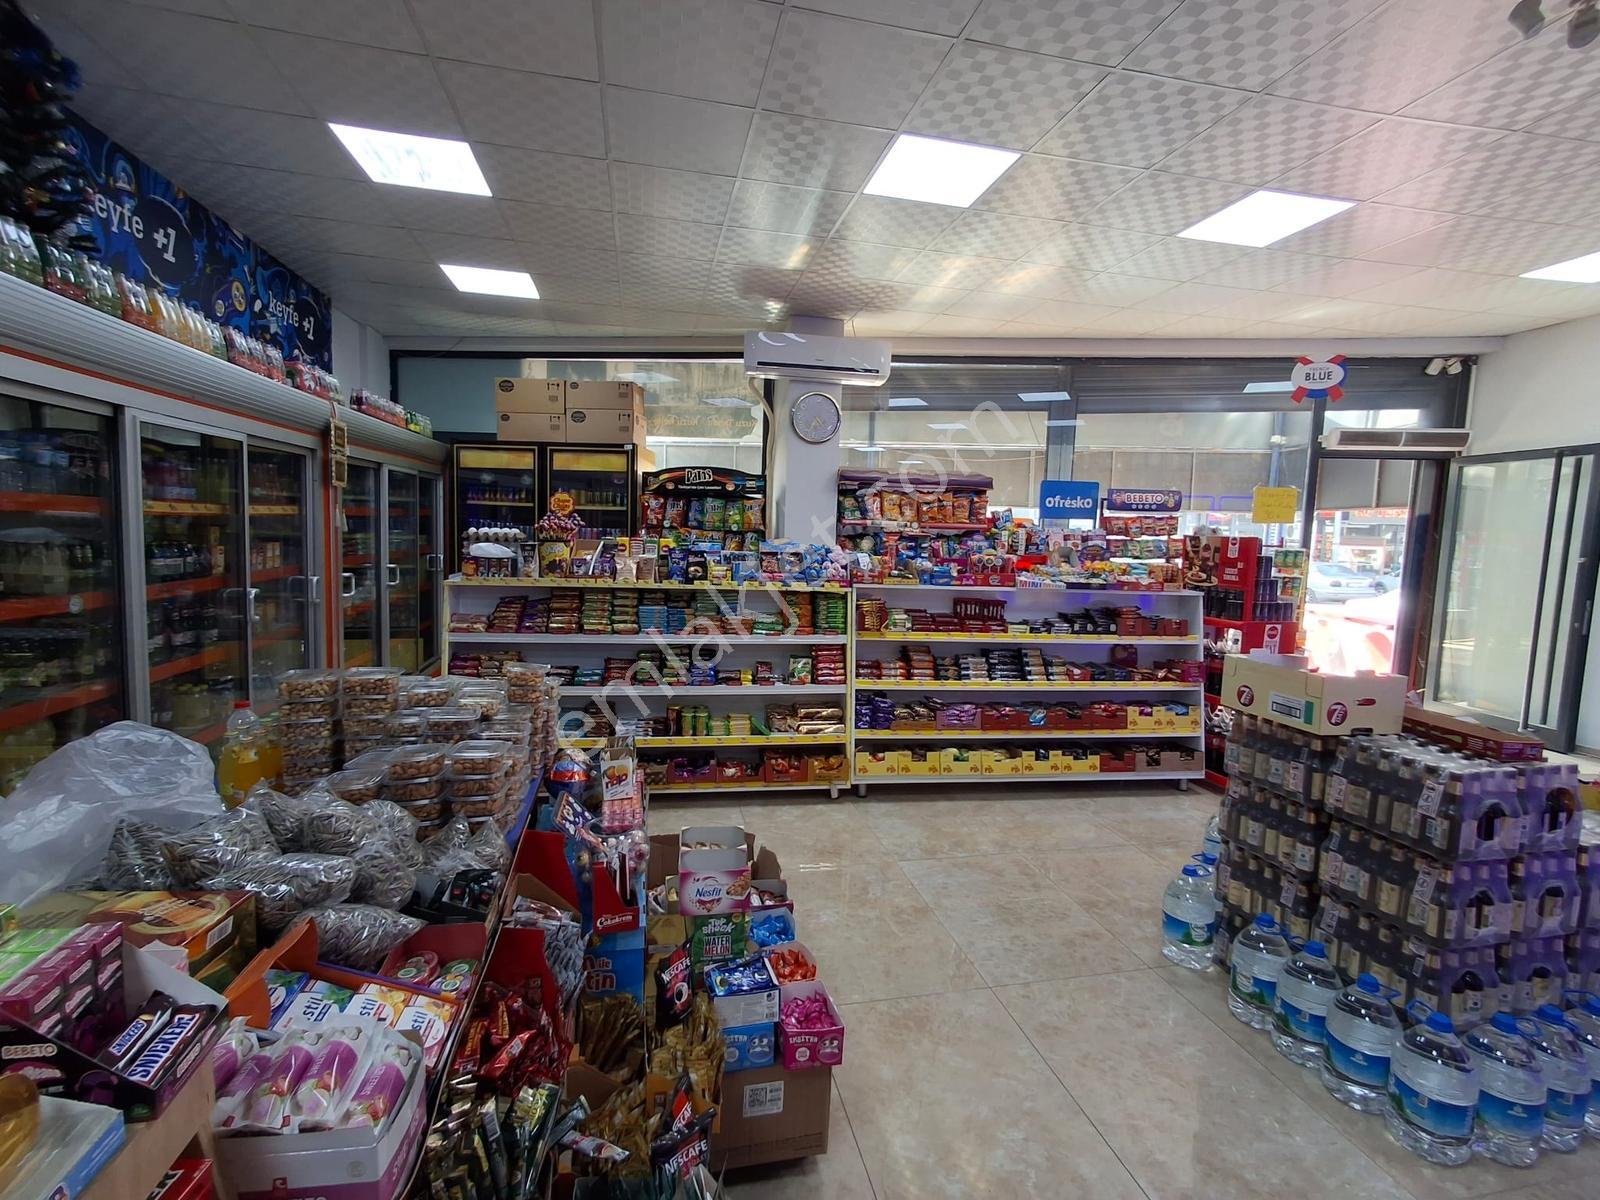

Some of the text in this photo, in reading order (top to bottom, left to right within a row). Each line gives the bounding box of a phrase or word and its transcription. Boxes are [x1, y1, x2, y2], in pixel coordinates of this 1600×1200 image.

[94, 193, 177, 263] eyfe +1
[268, 290, 315, 341] keyfe +1
[1304, 370, 1333, 382] BLUE
[1125, 493, 1164, 504] BEBETO
[695, 887, 722, 899] Nesfit
[703, 934, 731, 946] WATER
[703, 945, 731, 957] MELON
[112, 1020, 146, 1054] SNICKERS
